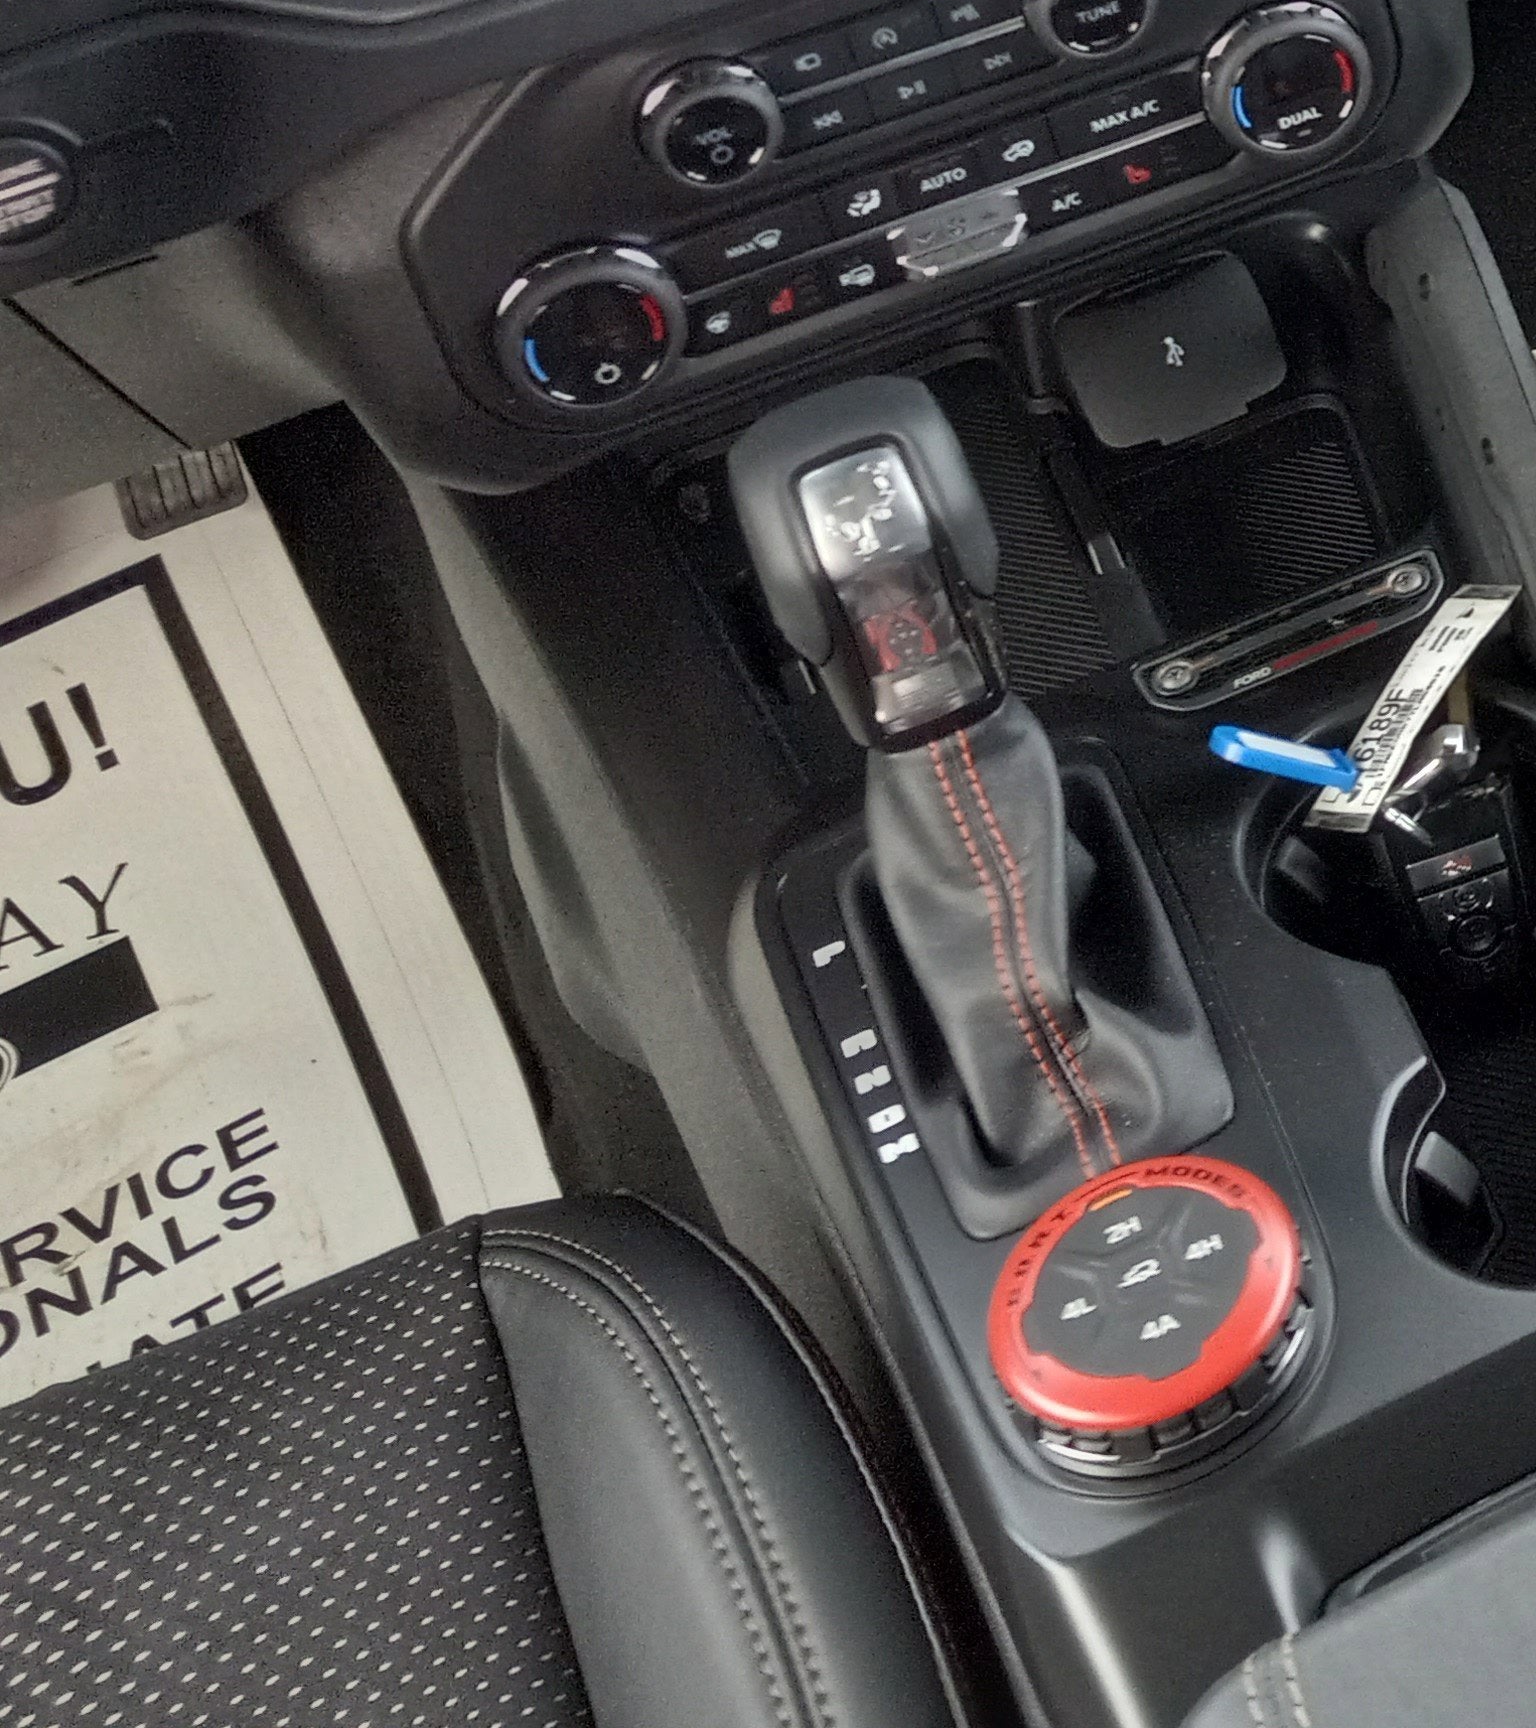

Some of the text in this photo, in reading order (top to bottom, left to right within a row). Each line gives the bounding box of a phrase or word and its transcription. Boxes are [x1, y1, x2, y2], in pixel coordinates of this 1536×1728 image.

[1075, 0, 1121, 23] TUNE
[1089, 99, 1161, 134] MAX A/C
[1277, 106, 1323, 130] DUAL
[920, 166, 968, 192] AUTO
[1052, 191, 1083, 213] A/C
